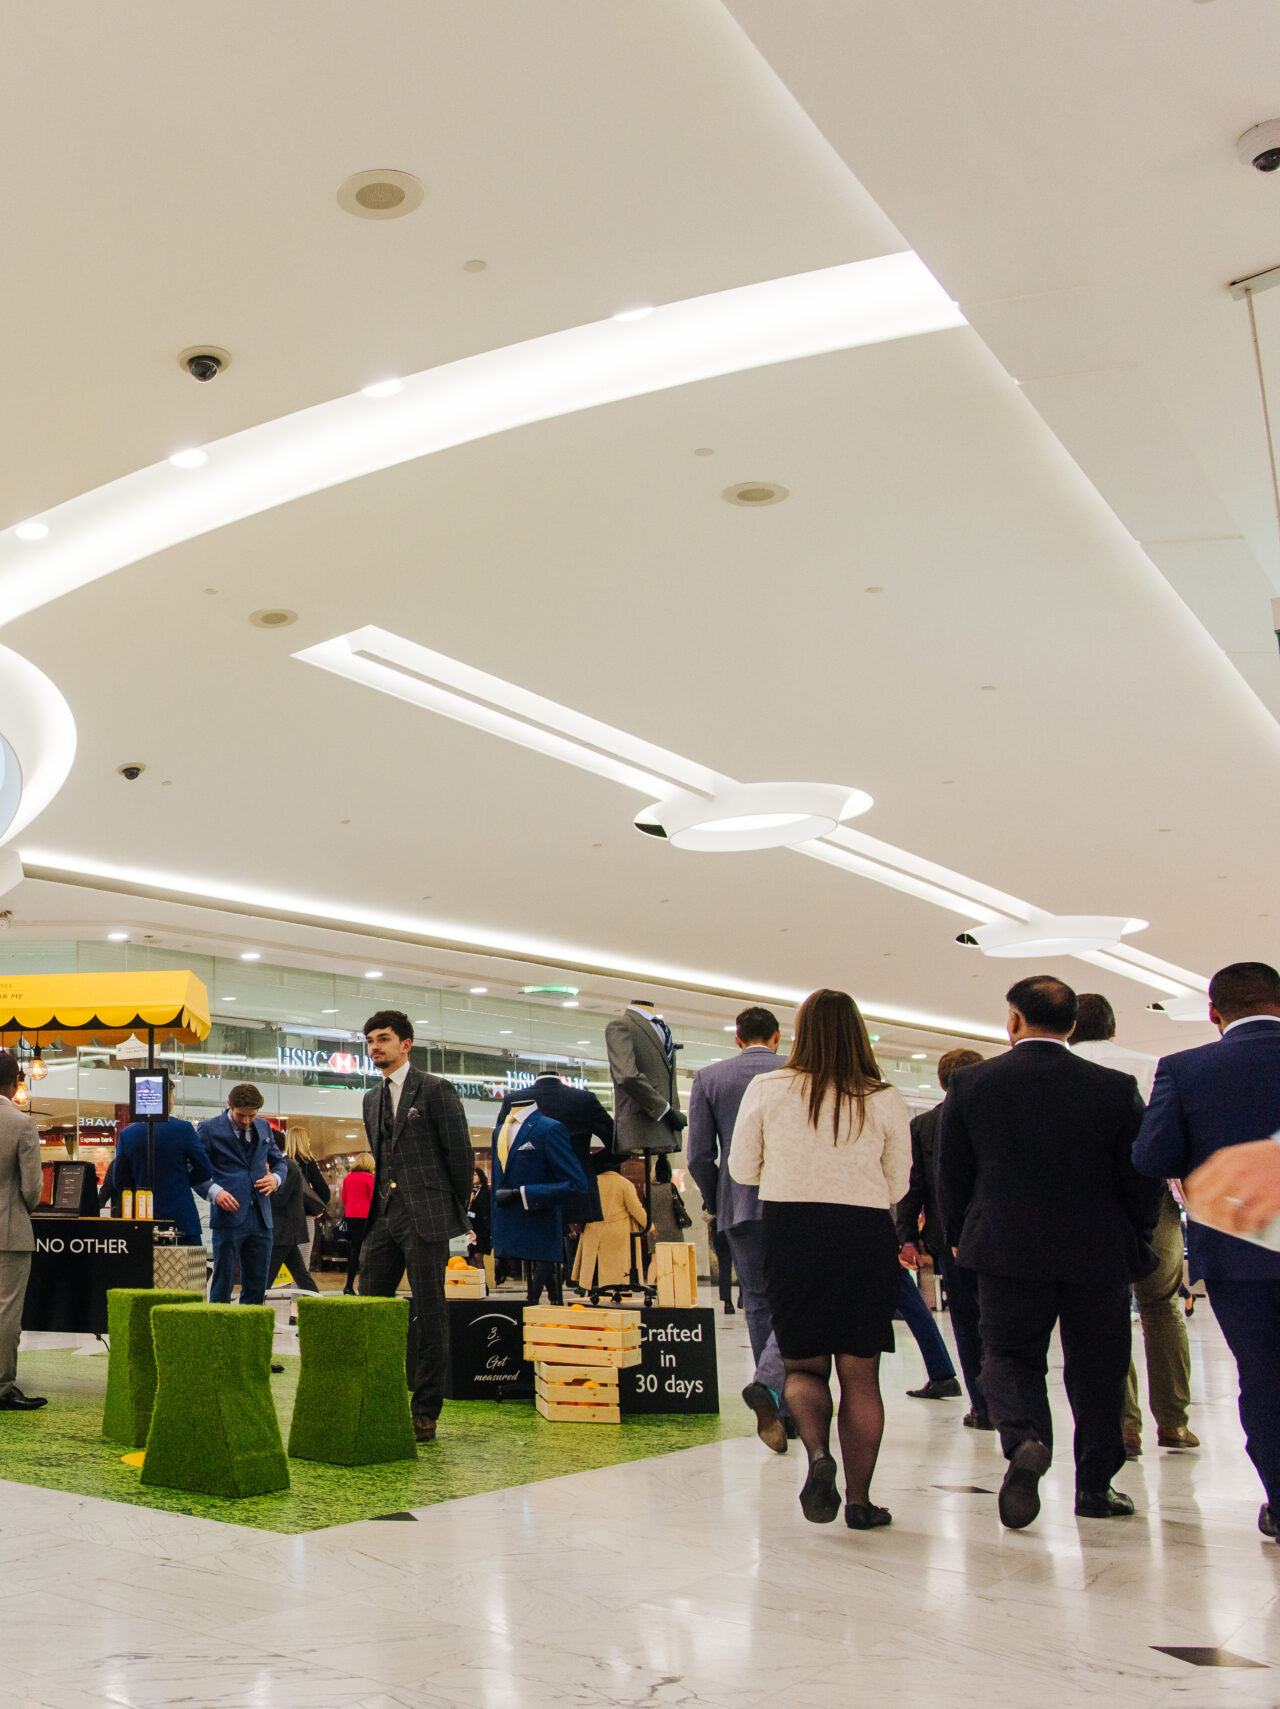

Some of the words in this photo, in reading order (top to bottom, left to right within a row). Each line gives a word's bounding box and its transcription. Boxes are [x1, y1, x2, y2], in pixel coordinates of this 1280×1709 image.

[276, 1046, 328, 1072] HSBC
[36, 1238, 65, 1253] NO
[70, 1239, 129, 1254] OTHER
[486, 1355, 510, 1370] Get
[660, 1350, 677, 1368] in
[474, 1370, 521, 1383] measured
[635, 1374, 658, 1393] 30
[664, 1374, 704, 1399] days
